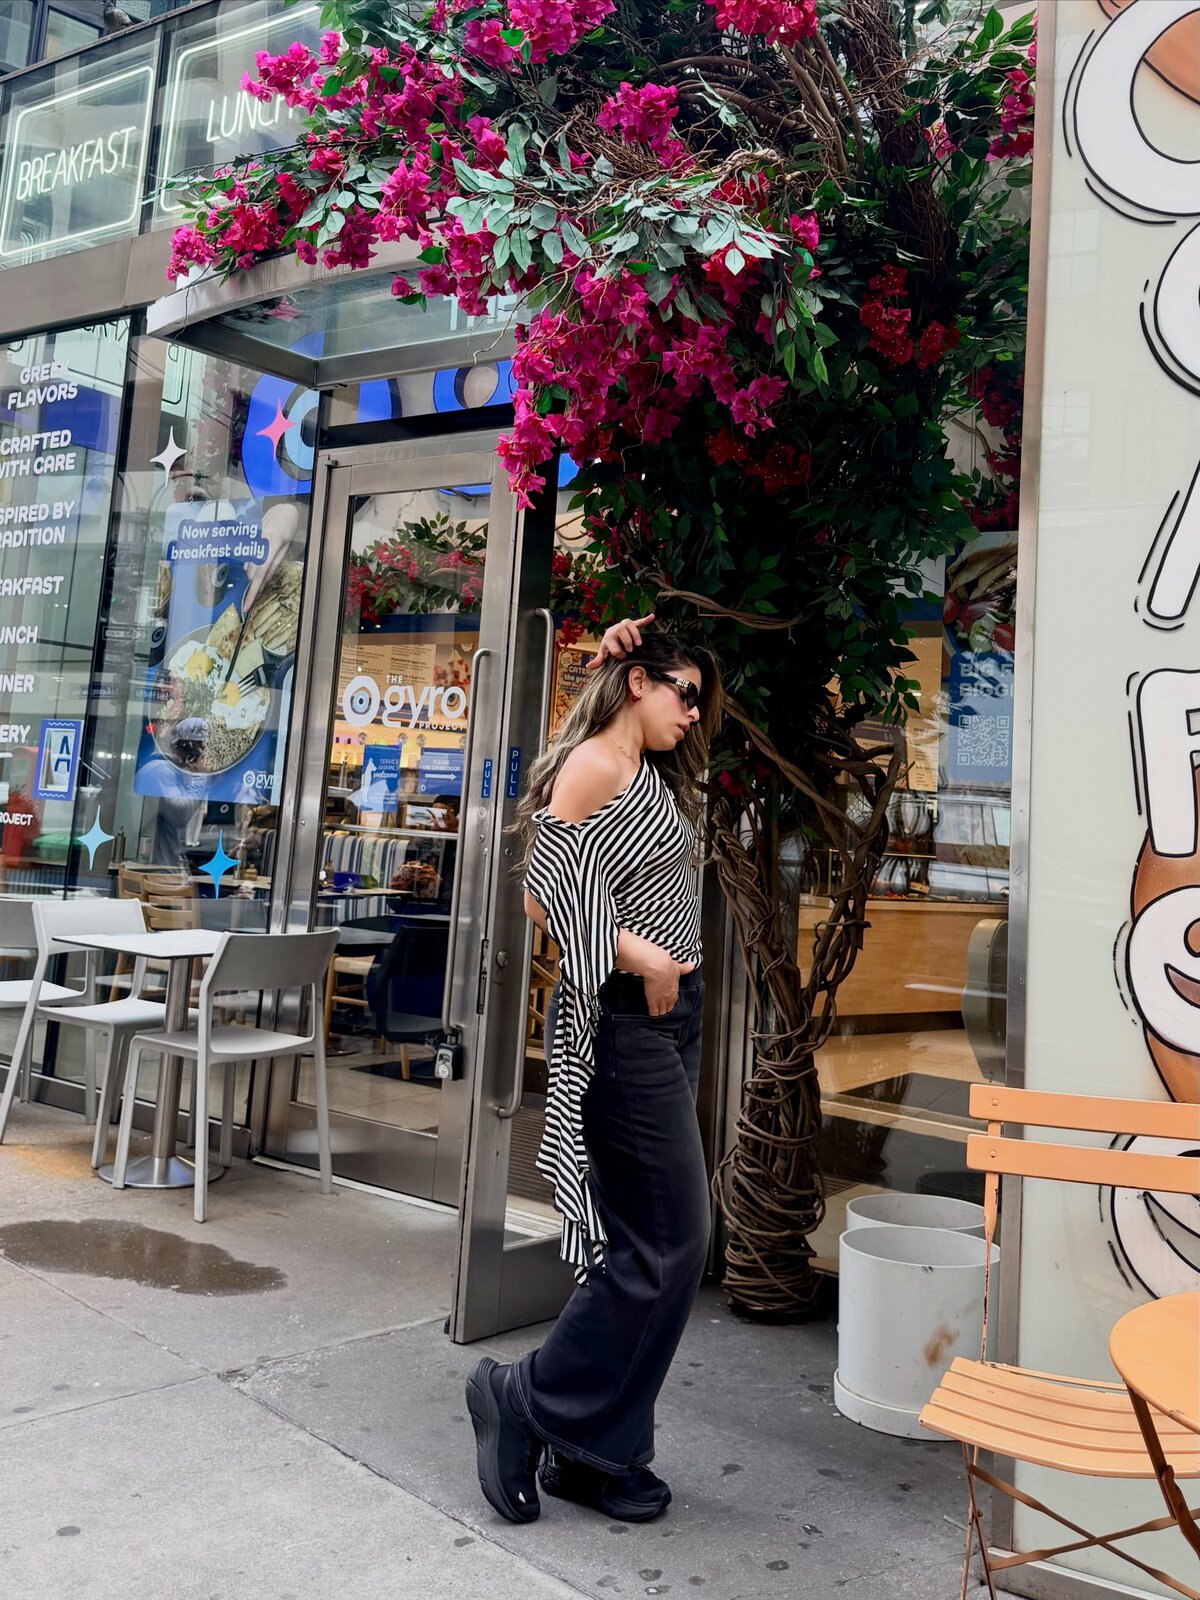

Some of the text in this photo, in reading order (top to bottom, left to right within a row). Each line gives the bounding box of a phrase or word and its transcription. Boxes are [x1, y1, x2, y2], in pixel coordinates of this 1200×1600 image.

[16, 125, 137, 201] BREAKFAST
[20, 360, 70, 385] GREEK
[7, 382, 78, 410] FLAVORS
[0, 429, 72, 456] CRAFTED
[33, 452, 77, 475] CARE
[52, 500, 75, 520] BY
[181, 521, 259, 540] Now serving
[170, 541, 265, 560] breakfast daily
[0, 673, 35, 693] NER
[385, 674, 403, 684] THE
[382, 685, 467, 729] gyro
[418, 720, 466, 731] PROJECT
[54, 735, 71, 772] A
[483, 761, 491, 797] PULL
[509, 749, 519, 796] PULL
